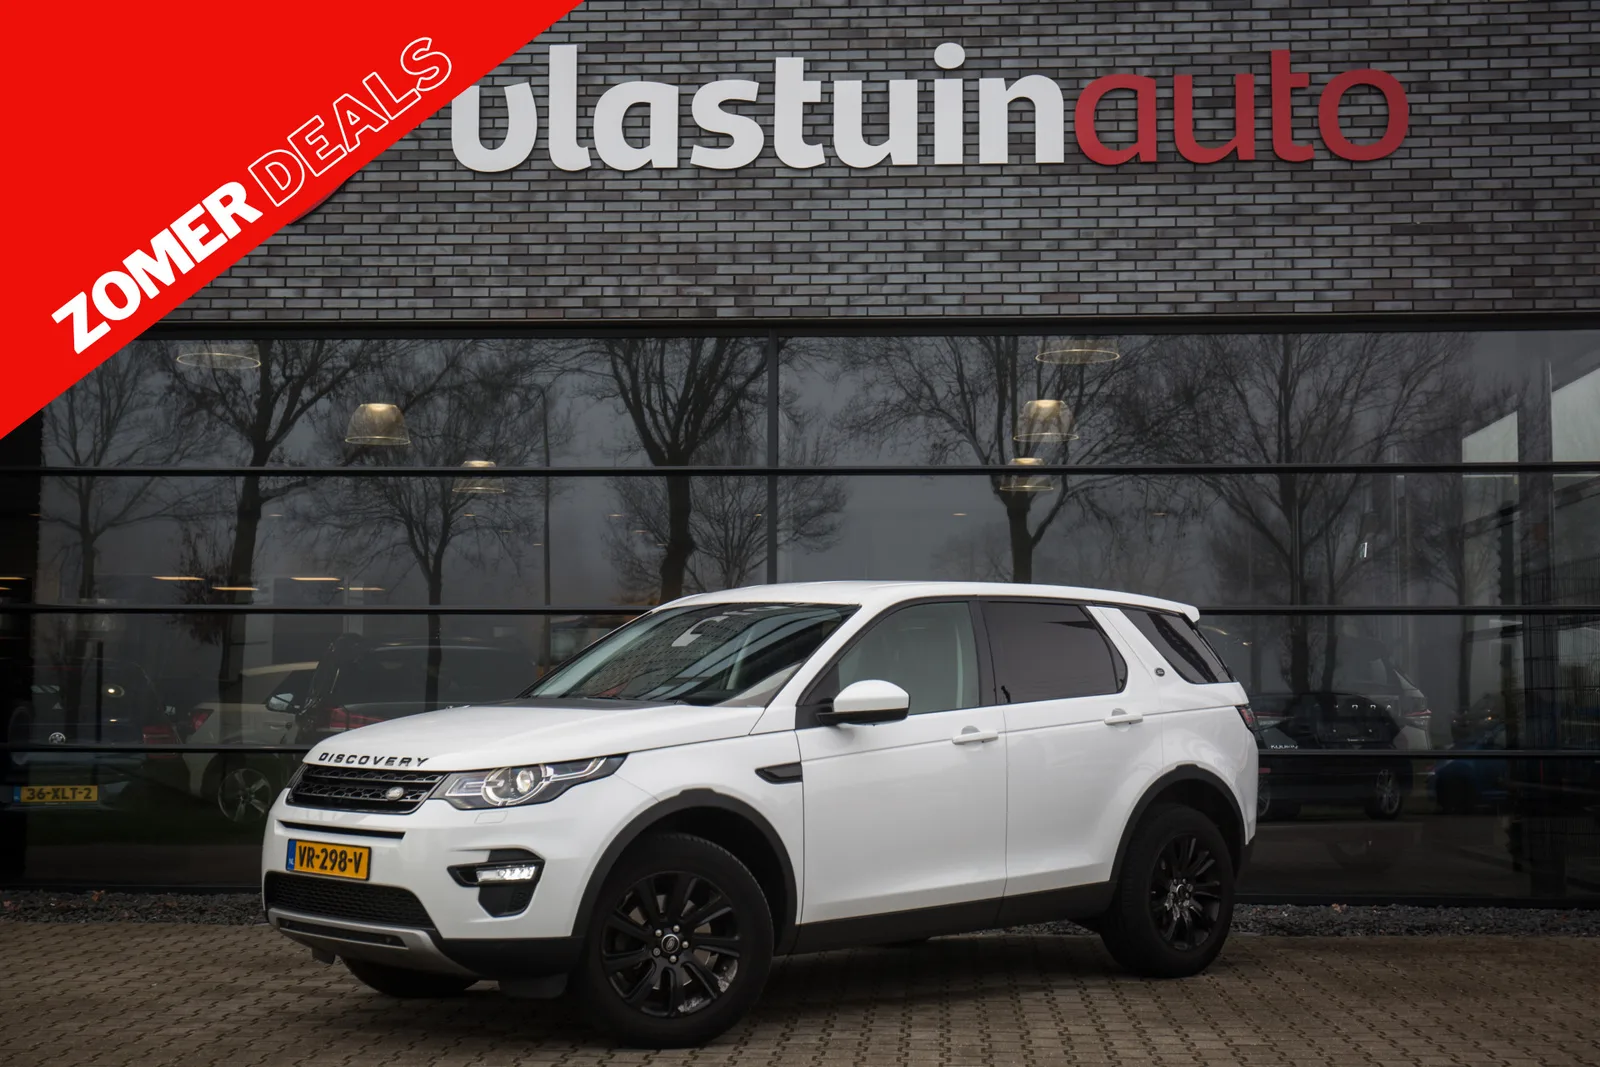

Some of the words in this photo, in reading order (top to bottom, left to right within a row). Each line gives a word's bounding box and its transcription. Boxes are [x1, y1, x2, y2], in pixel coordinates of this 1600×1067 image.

[318, 752, 430, 767] DISCOVERY
[26, 787, 92, 800] 36-XLT-2
[298, 845, 363, 874] VR-298-V
